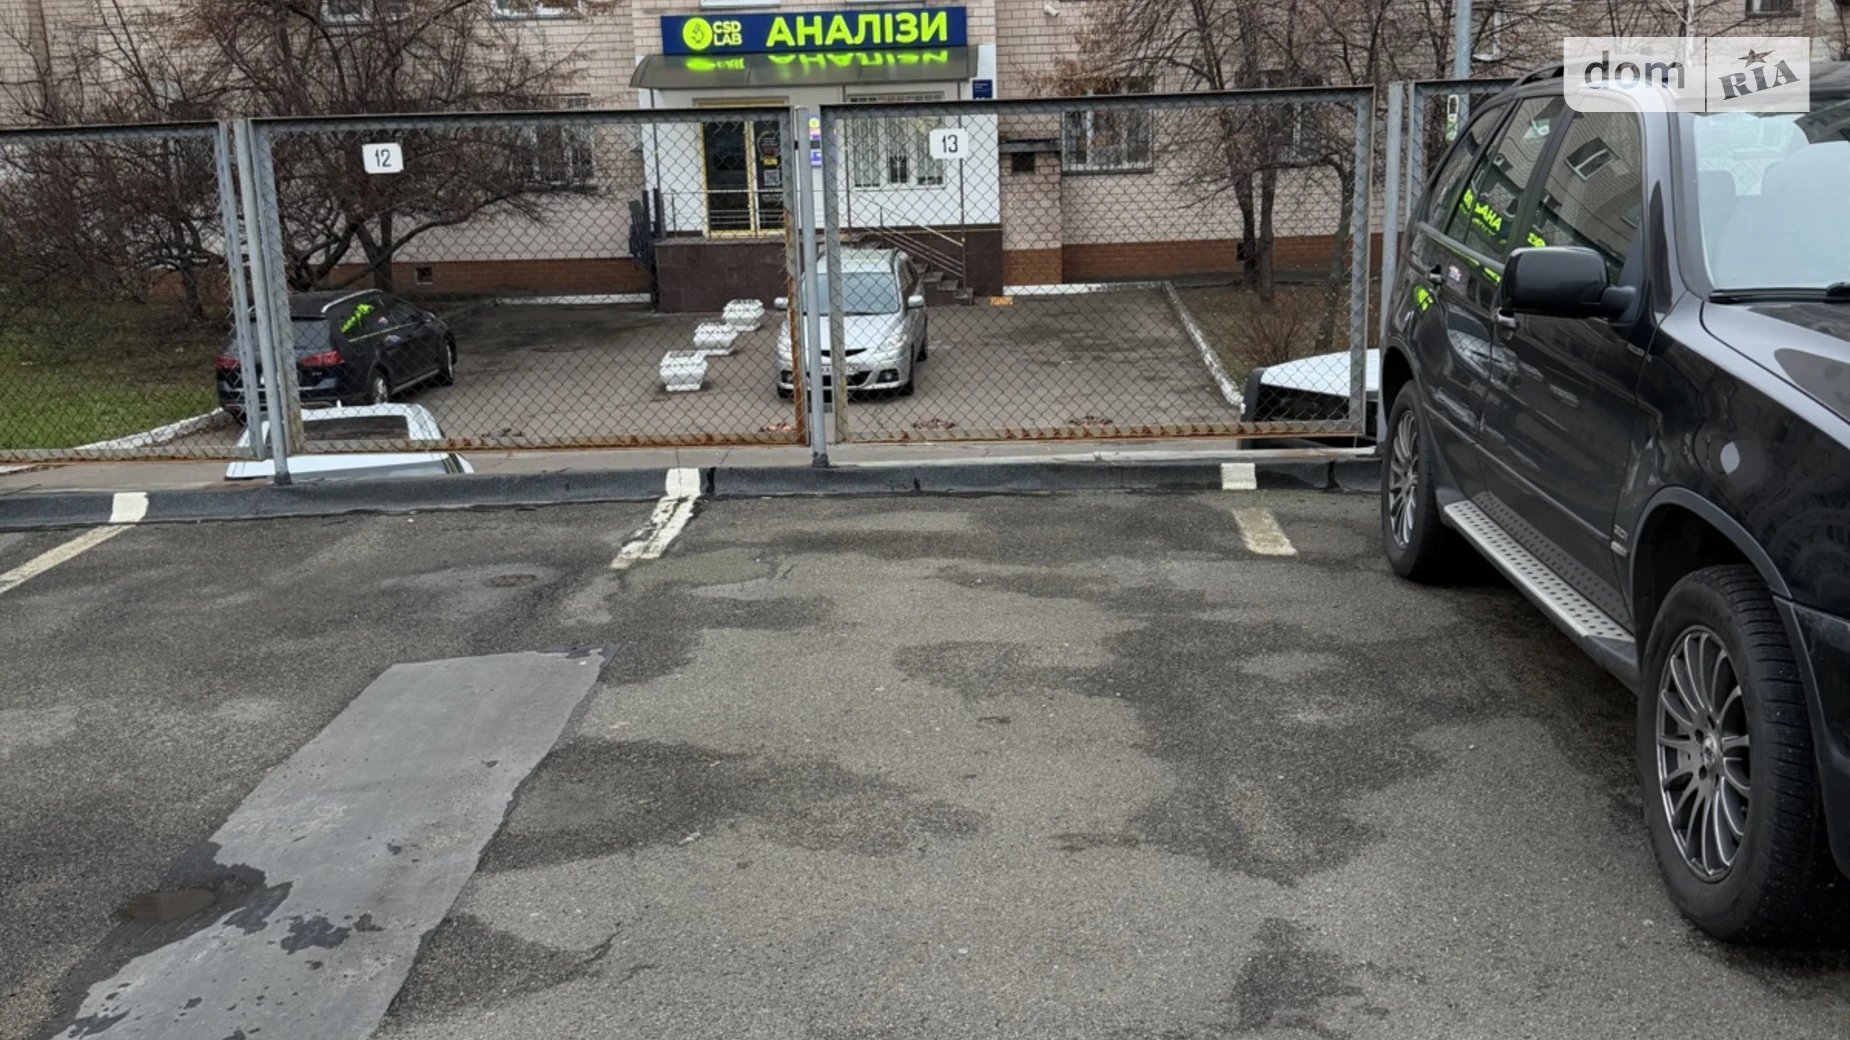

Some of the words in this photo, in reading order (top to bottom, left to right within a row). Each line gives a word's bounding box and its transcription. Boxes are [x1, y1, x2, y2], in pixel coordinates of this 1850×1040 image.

[713, 21, 742, 33] CSD
[766, 11, 948, 47] АНАЛІЗИ
[713, 33, 743, 46] LAB
[941, 134, 958, 153] 13
[374, 148, 392, 167] 12
